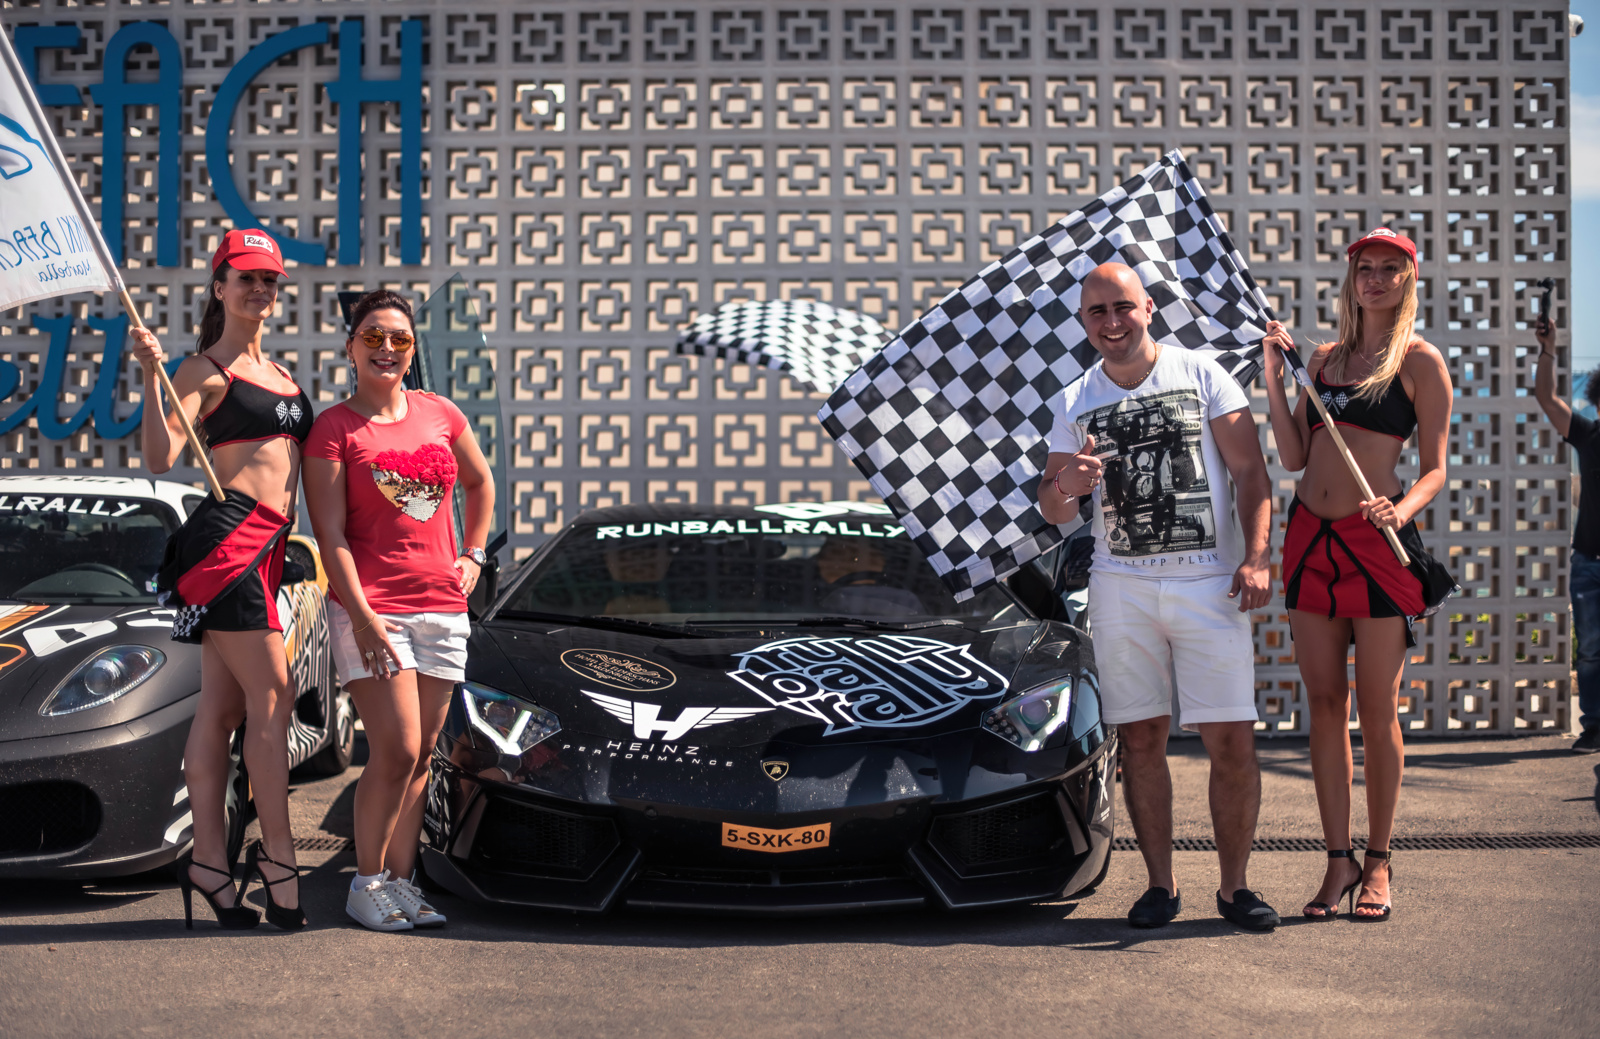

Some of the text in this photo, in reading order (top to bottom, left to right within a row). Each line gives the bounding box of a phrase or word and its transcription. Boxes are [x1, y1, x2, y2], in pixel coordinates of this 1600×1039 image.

[596, 519, 906, 539] RUNBALLRALLY
[562, 743, 734, 768] PERFORMANCE
[606, 740, 700, 756] HEINZ
[727, 828, 827, 848] 5-SXK-80
